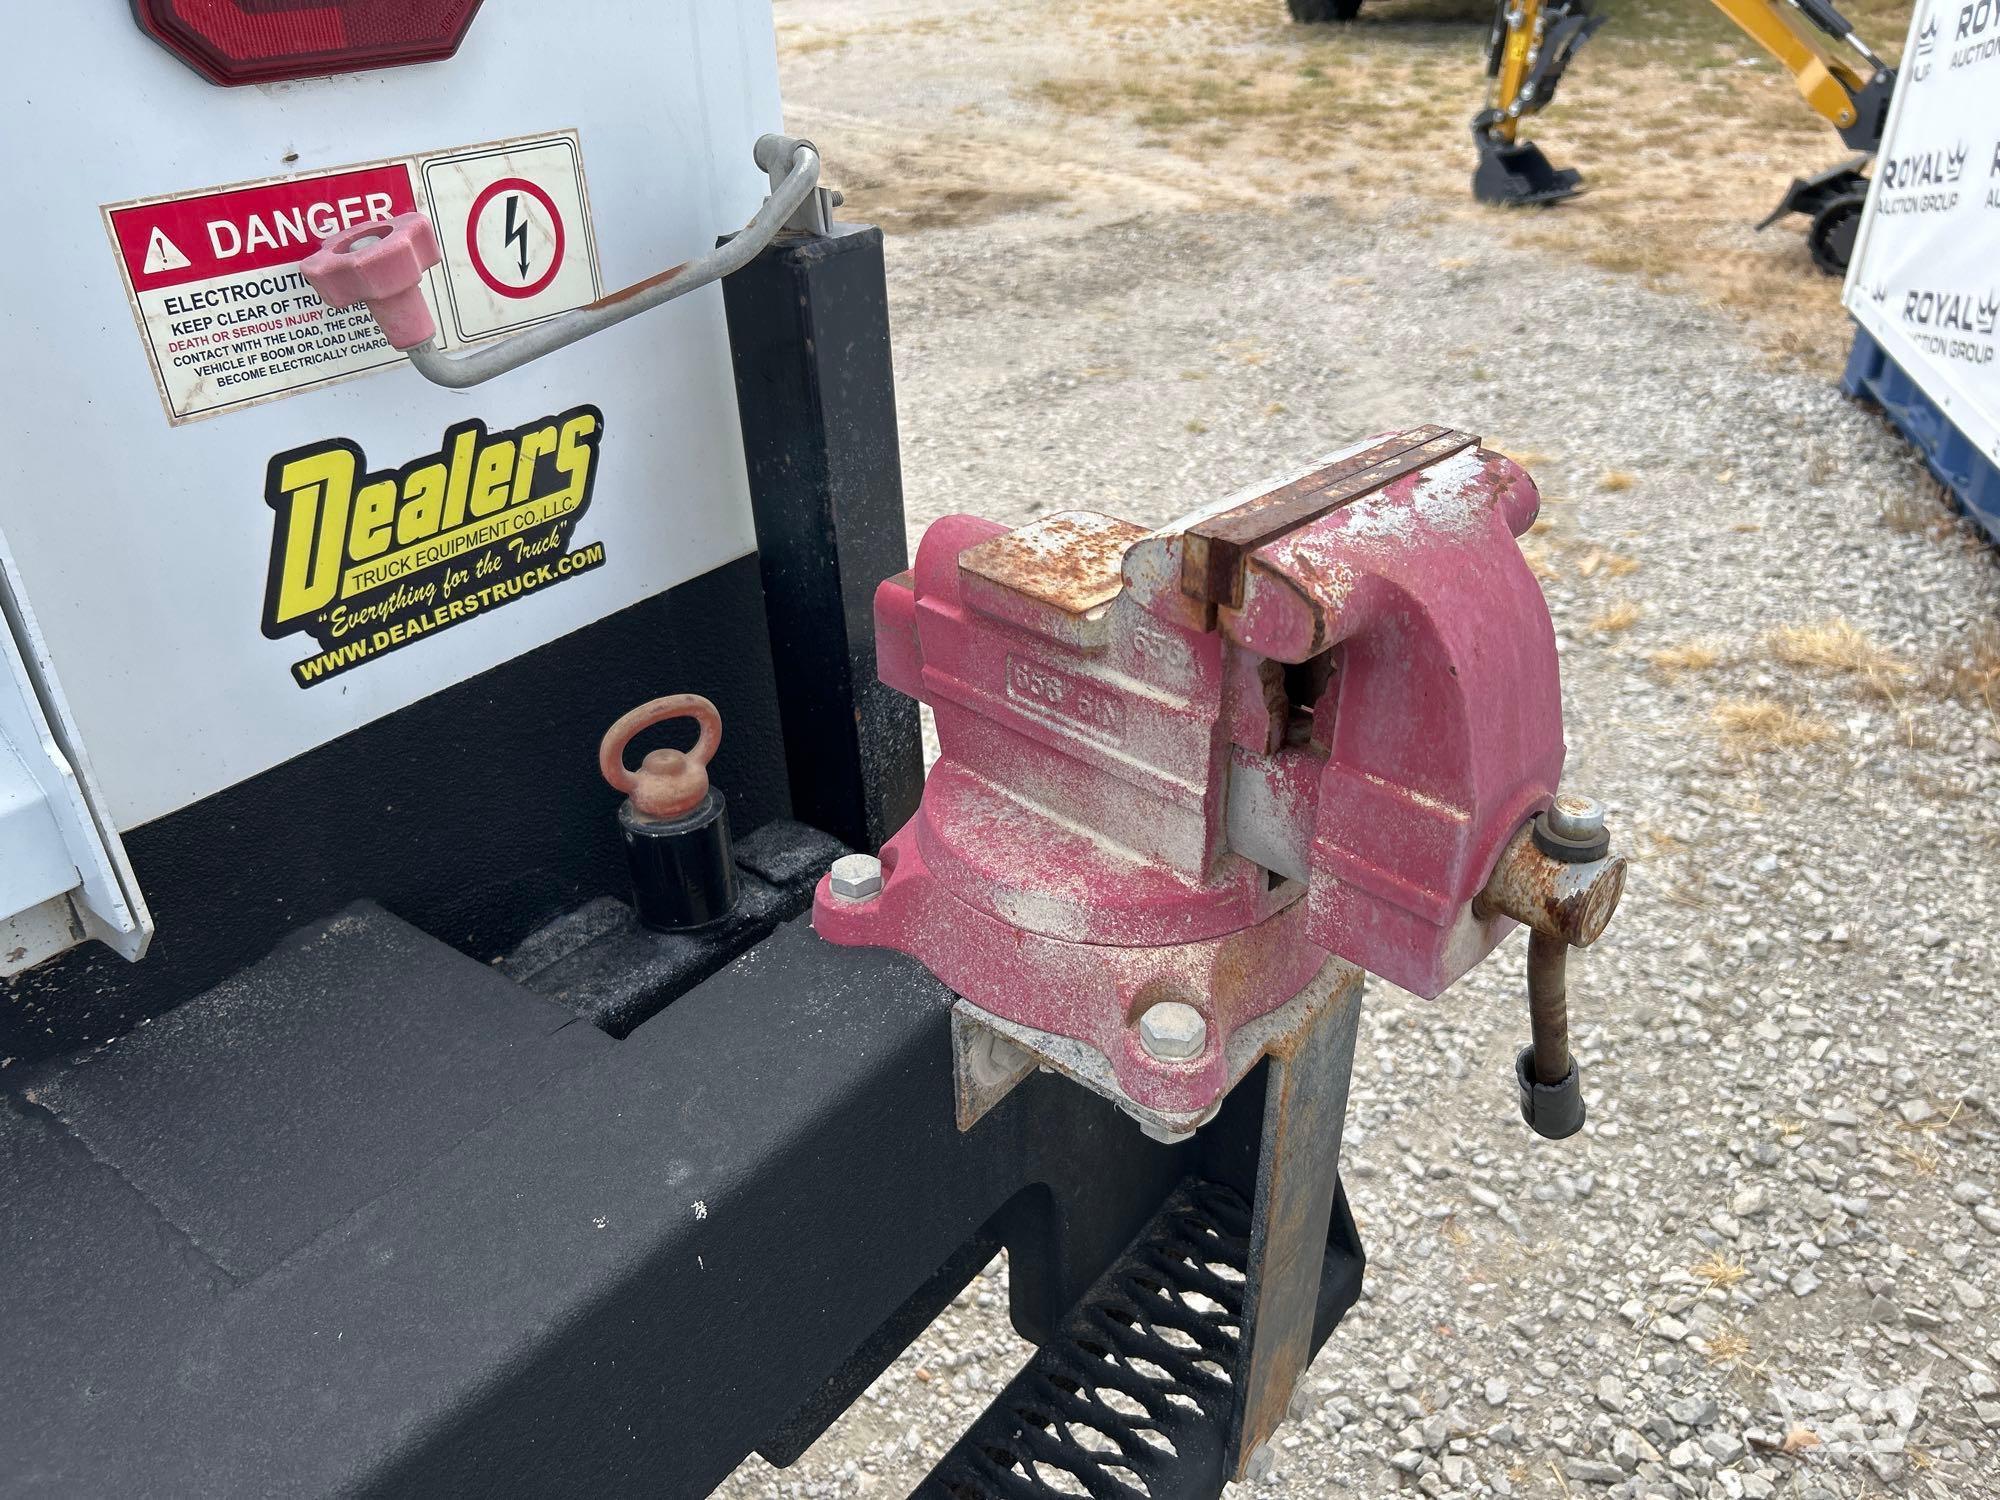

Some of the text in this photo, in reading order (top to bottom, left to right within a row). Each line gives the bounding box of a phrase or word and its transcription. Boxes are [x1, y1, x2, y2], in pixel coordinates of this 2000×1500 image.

[1881, 150, 1943, 190] ROYAL
[206, 192, 394, 260] DANGER
[164, 271, 311, 316] ELECTROCUTI
[171, 295, 323, 337] KEEP CLEAR OF TRU
[1903, 289, 1973, 331] ROYAL
[168, 300, 367, 353] DEATH OR SERIOUS INJURY CAN RE
[173, 346, 229, 367] CONTACT
[232, 340, 262, 354] WITH
[263, 332, 286, 347] THE
[289, 324, 323, 341] LOAD,
[324, 319, 347, 334] THE
[194, 357, 245, 378] VEHICLE
[248, 354, 258, 366] IF
[260, 345, 296, 362] BOOM
[297, 340, 314, 353] OR
[316, 334, 346, 349] LOAD
[348, 328, 371, 341] LINE
[217, 366, 267, 388] BECOME
[269, 346, 348, 375] ELECTRICALLY
[1949, 340, 1994, 363] GROUP
[276, 414, 596, 623] Dealers
[352, 555, 412, 591] TRUCK
[416, 519, 510, 569] EQUIPMENT
[443, 567, 470, 600] for
[475, 550, 503, 579] the
[299, 544, 603, 681] WWW.DEALERSTRUCK.COM
